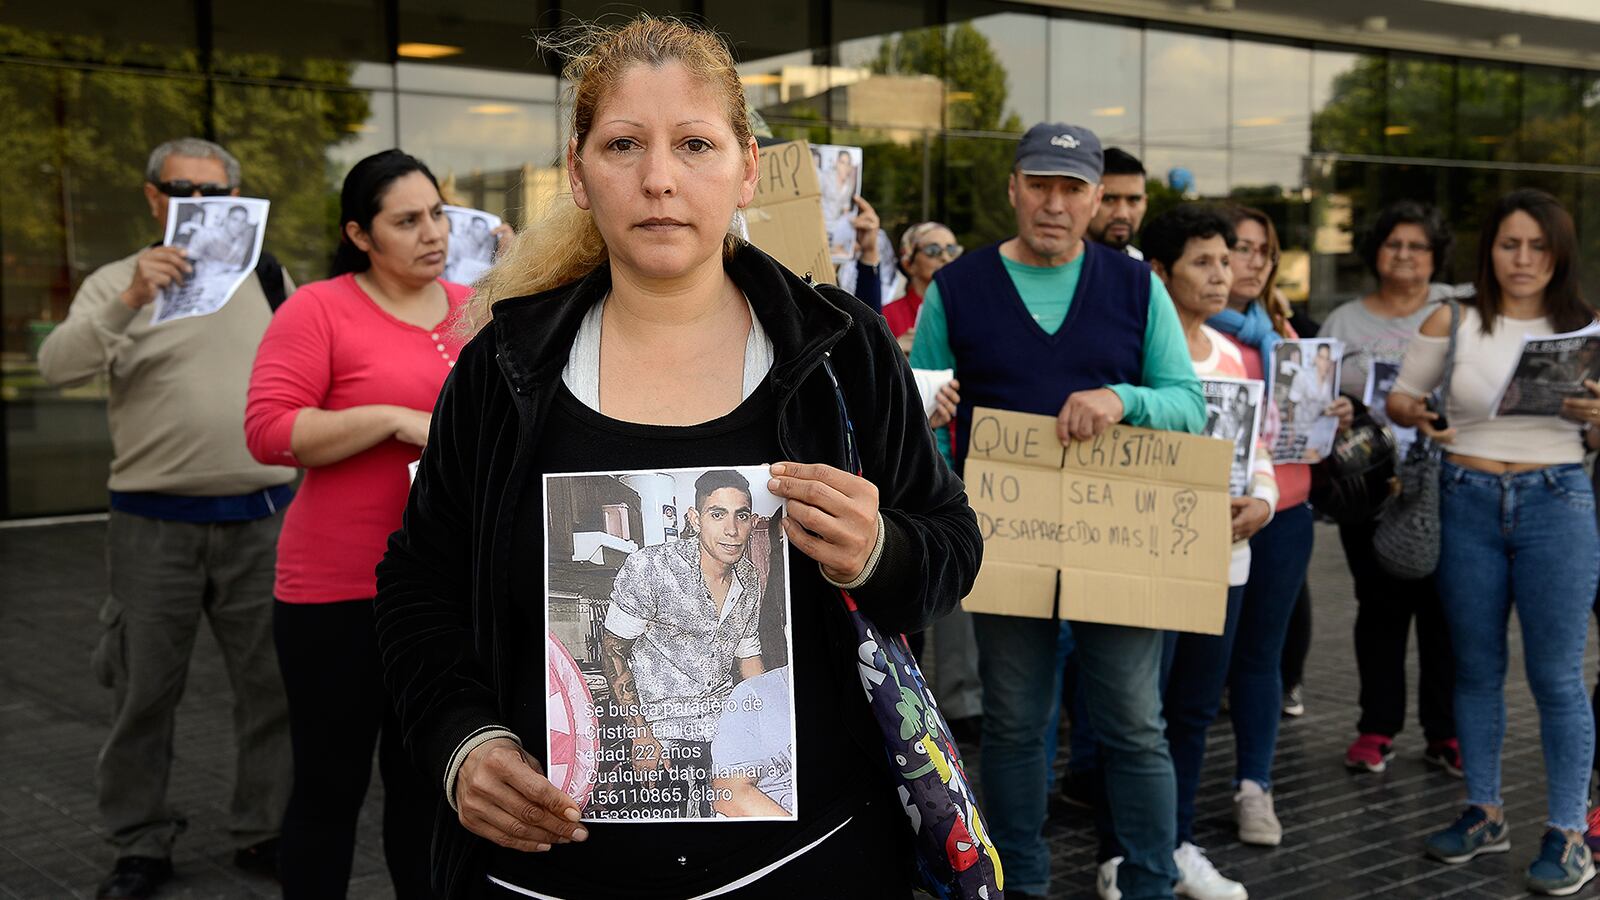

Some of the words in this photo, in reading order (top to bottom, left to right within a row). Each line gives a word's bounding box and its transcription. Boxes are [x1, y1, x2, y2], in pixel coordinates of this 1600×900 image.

[972, 416, 1040, 458] QUE
[980, 472, 1020, 503] NO
[1068, 481, 1114, 506] SEA
[1135, 490, 1157, 514] UN
[584, 702, 605, 718] Se
[609, 700, 659, 718] busca
[662, 696, 738, 717] paradero
[743, 694, 764, 712] de
[585, 724, 647, 740] Cristian
[585, 745, 631, 761] edad:
[635, 744, 656, 760] 22
[660, 740, 702, 760] años
[585, 766, 665, 786] Cualquier
[669, 764, 706, 781] dato
[711, 762, 764, 779] llamar
[691, 785, 733, 801] claro
